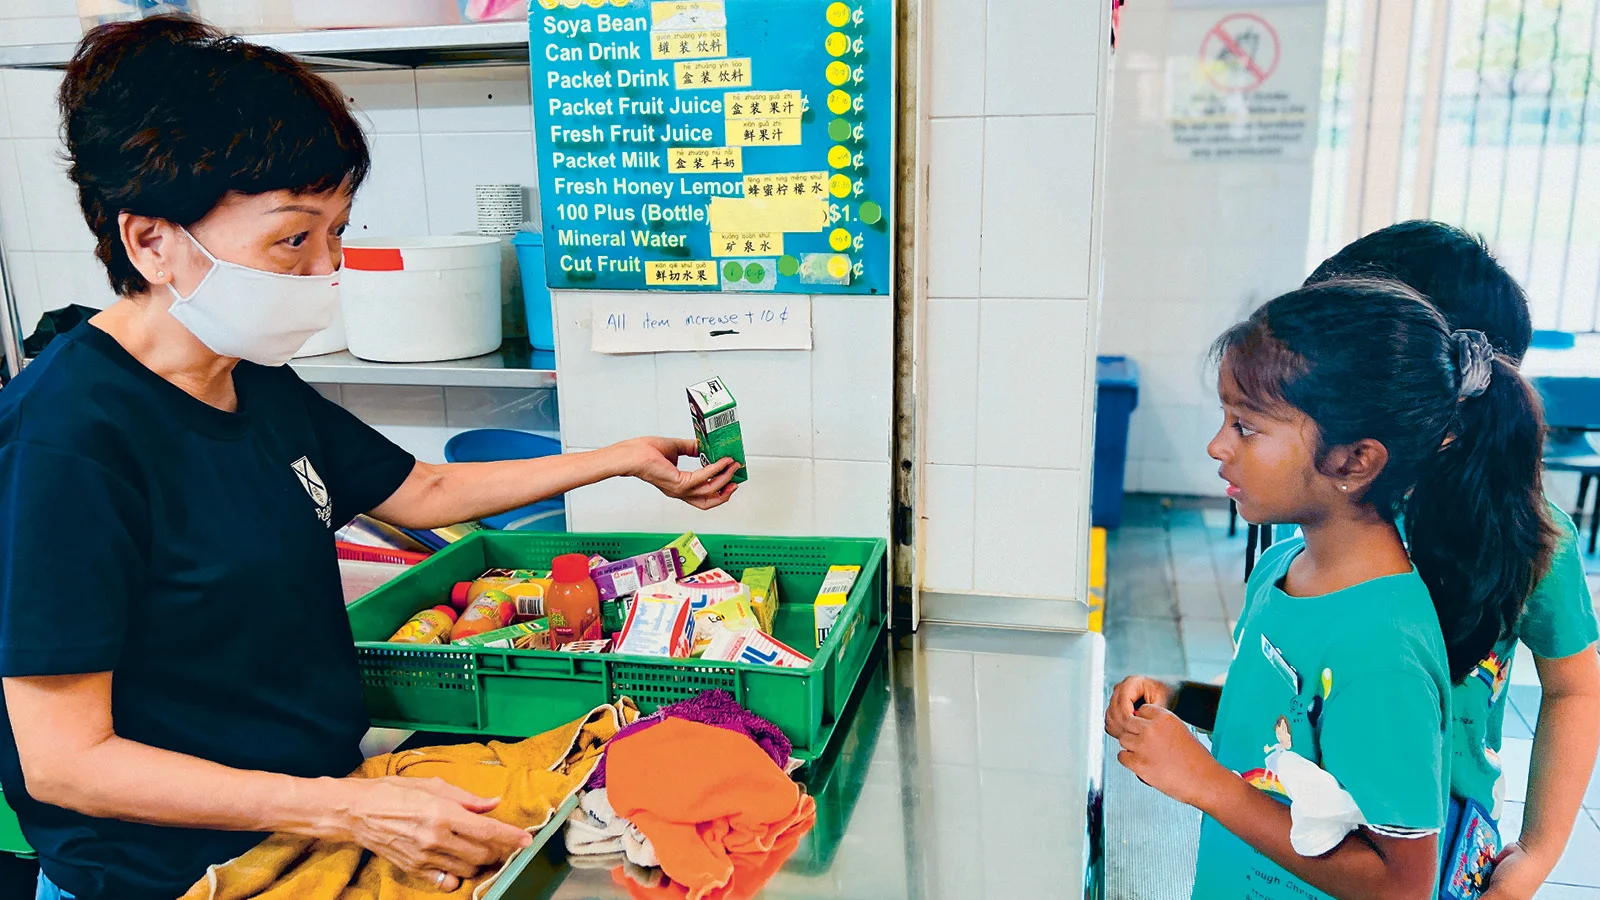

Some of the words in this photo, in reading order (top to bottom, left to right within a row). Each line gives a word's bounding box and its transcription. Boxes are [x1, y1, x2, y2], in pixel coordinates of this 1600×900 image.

[544, 15, 592, 38] Soya
[598, 15, 647, 31] Bean
[545, 44, 583, 61] Can
[590, 42, 641, 60] Drink
[658, 39, 722, 54] 罐装饮料
[547, 71, 612, 88] Packet
[618, 68, 669, 87] Drink
[682, 69, 744, 84] 盒装饮料
[549, 97, 613, 115] Packet
[619, 97, 664, 114] Fruit
[670, 96, 722, 113] Juice
[732, 101, 794, 115] 盒装果汁
[551, 125, 604, 142] Fresh
[610, 125, 655, 141] Fruit
[661, 124, 713, 141] Juice
[744, 128, 783, 142] 鲜果汁
[552, 152, 616, 168] Packet
[622, 152, 660, 168] Milk
[676, 157, 735, 169] 盒装牛奶
[554, 178, 607, 194] Fresh
[613, 177, 674, 199] Honey
[680, 178, 743, 195] Lemon
[748, 182, 823, 197] 蜂蜜柠檬水
[557, 204, 588, 220] 100
[595, 204, 635, 220] Plus
[641, 203, 710, 225] (Bottle)
[829, 203, 877, 224] $1.
[559, 229, 625, 246] Mineral
[632, 230, 687, 246] Water
[725, 240, 771, 253] 矿泉水
[560, 256, 593, 272] Cut
[597, 256, 641, 271] Fruit
[655, 269, 708, 282] 鲜切水果
[606, 312, 626, 330] All
[642, 312, 671, 329] item
[685, 313, 738, 327] increase
[760, 309, 774, 322] 10
[1251, 867, 1282, 885] ough
